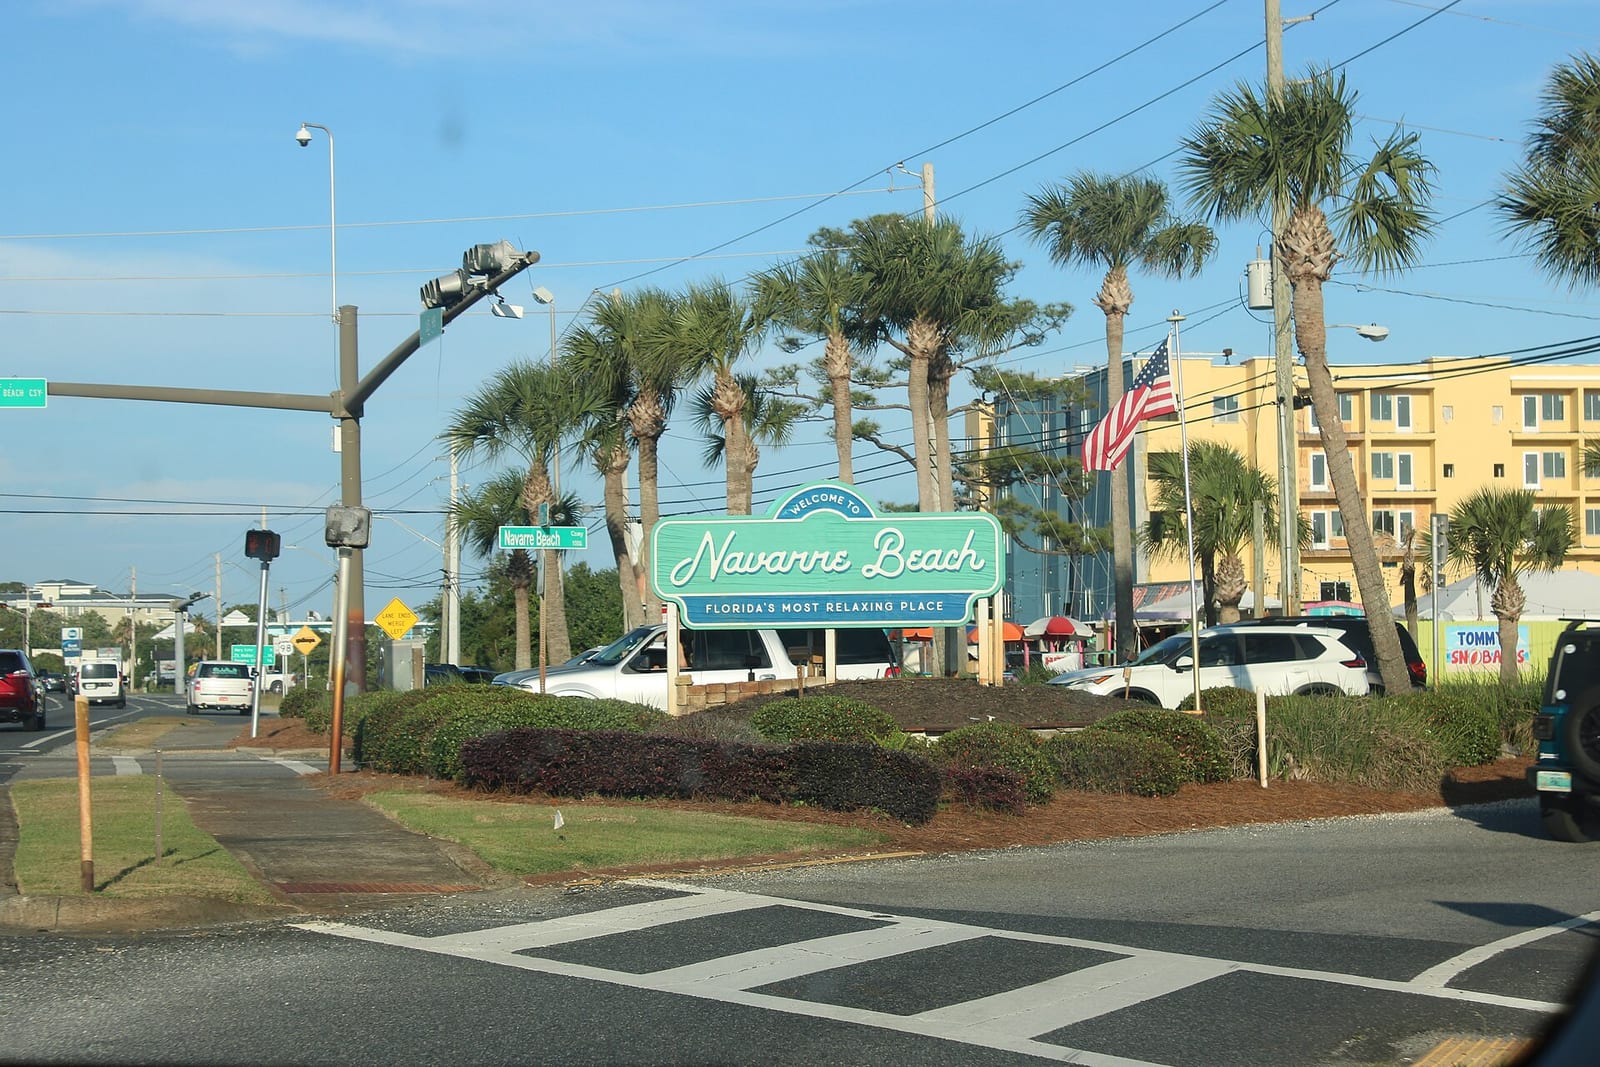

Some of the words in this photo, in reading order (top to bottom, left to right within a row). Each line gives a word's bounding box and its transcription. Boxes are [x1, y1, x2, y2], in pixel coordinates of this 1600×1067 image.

[3, 388, 24, 397] BEACH
[790, 493, 845, 515] WELCOME
[847, 500, 860, 514] TO
[504, 529, 534, 546] Navarre
[536, 529, 561, 547] Beach
[670, 530, 852, 587] Navarre
[861, 527, 985, 578] Beach
[706, 602, 775, 614] FLORIDA'S
[782, 603, 820, 613] MOST
[826, 602, 894, 612] RELAXING
[900, 601, 944, 611] PLACE
[280, 644, 292, 653] 98
